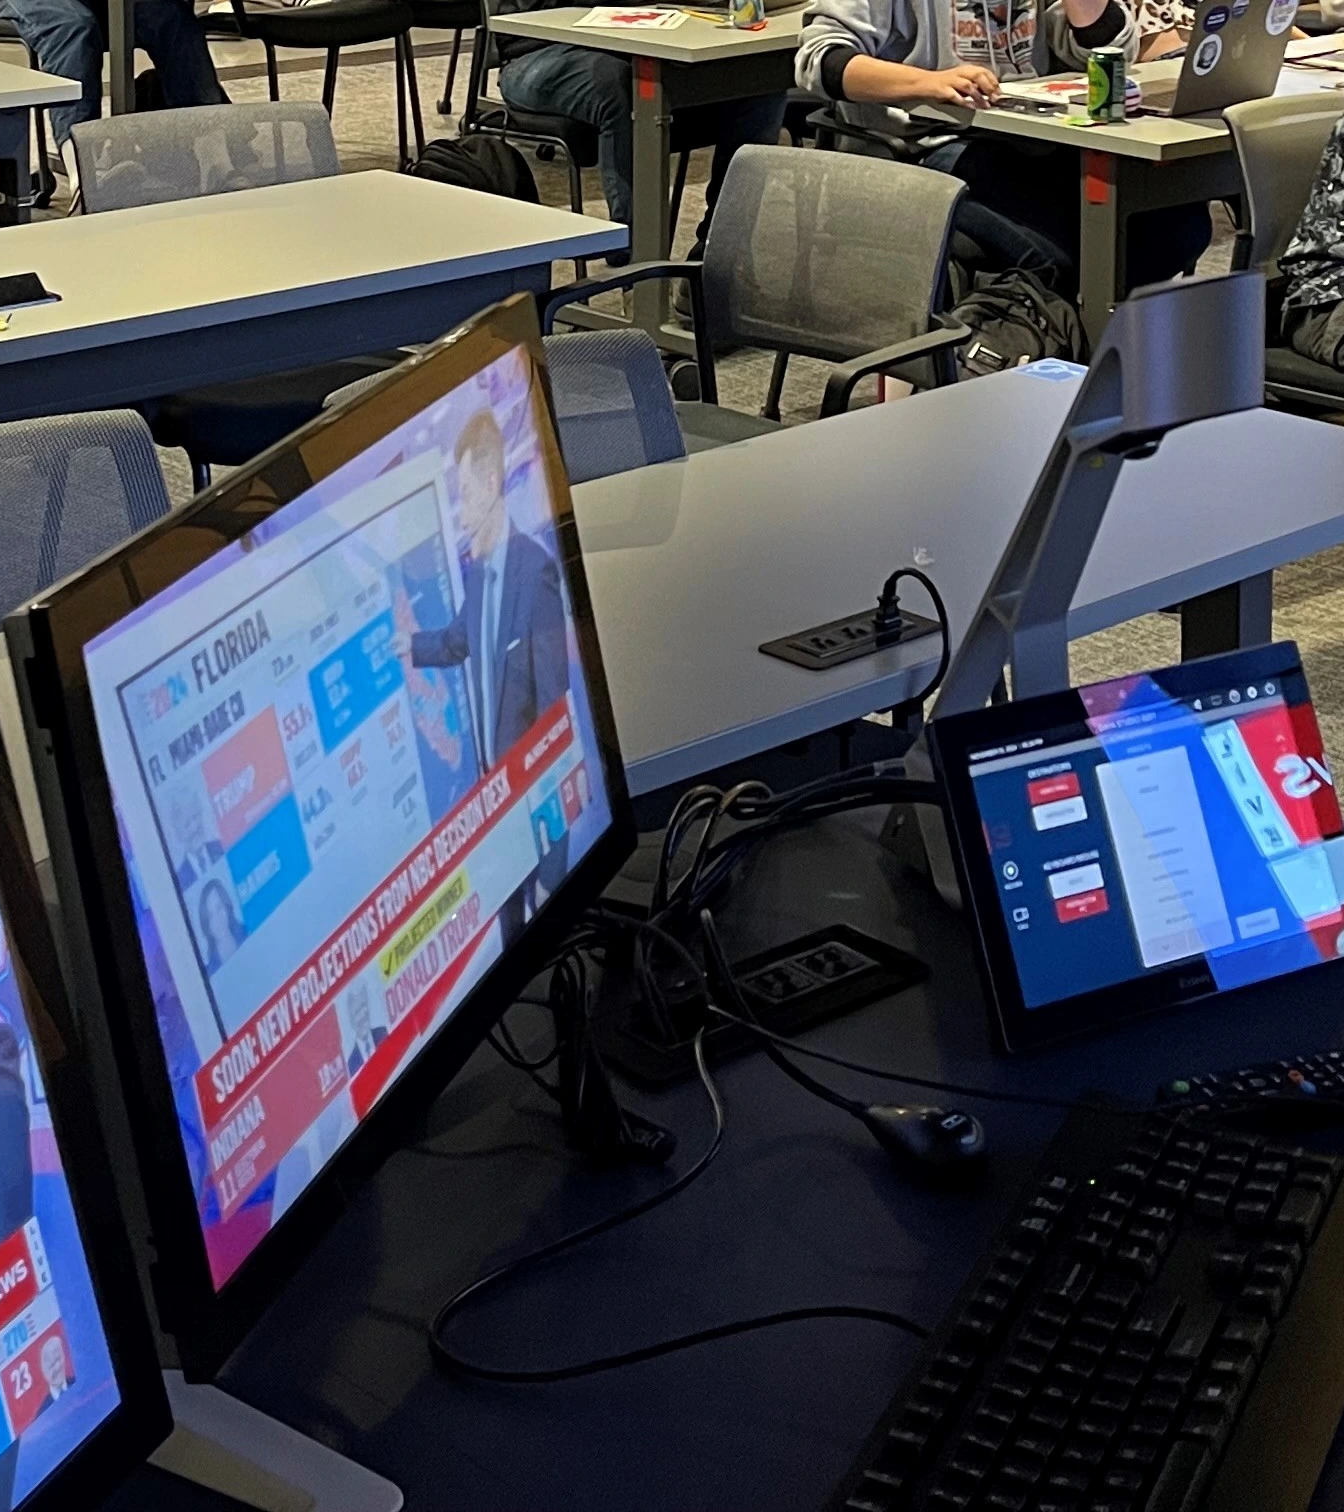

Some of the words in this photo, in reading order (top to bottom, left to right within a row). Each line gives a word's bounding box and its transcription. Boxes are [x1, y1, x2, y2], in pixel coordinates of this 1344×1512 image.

[191, 609, 271, 694] FLORIDA
[211, 1032, 260, 1104] SOON:
[256, 993, 292, 1058] NEW
[288, 906, 380, 1024] PROJECTIONS
[375, 869, 413, 931] FROM
[408, 845, 437, 897] NBC
[386, 941, 440, 1024] DONALD
[439, 890, 481, 963] TRUMP
[210, 1094, 265, 1172] INDIANA
[11, 1361, 33, 1401] 23
